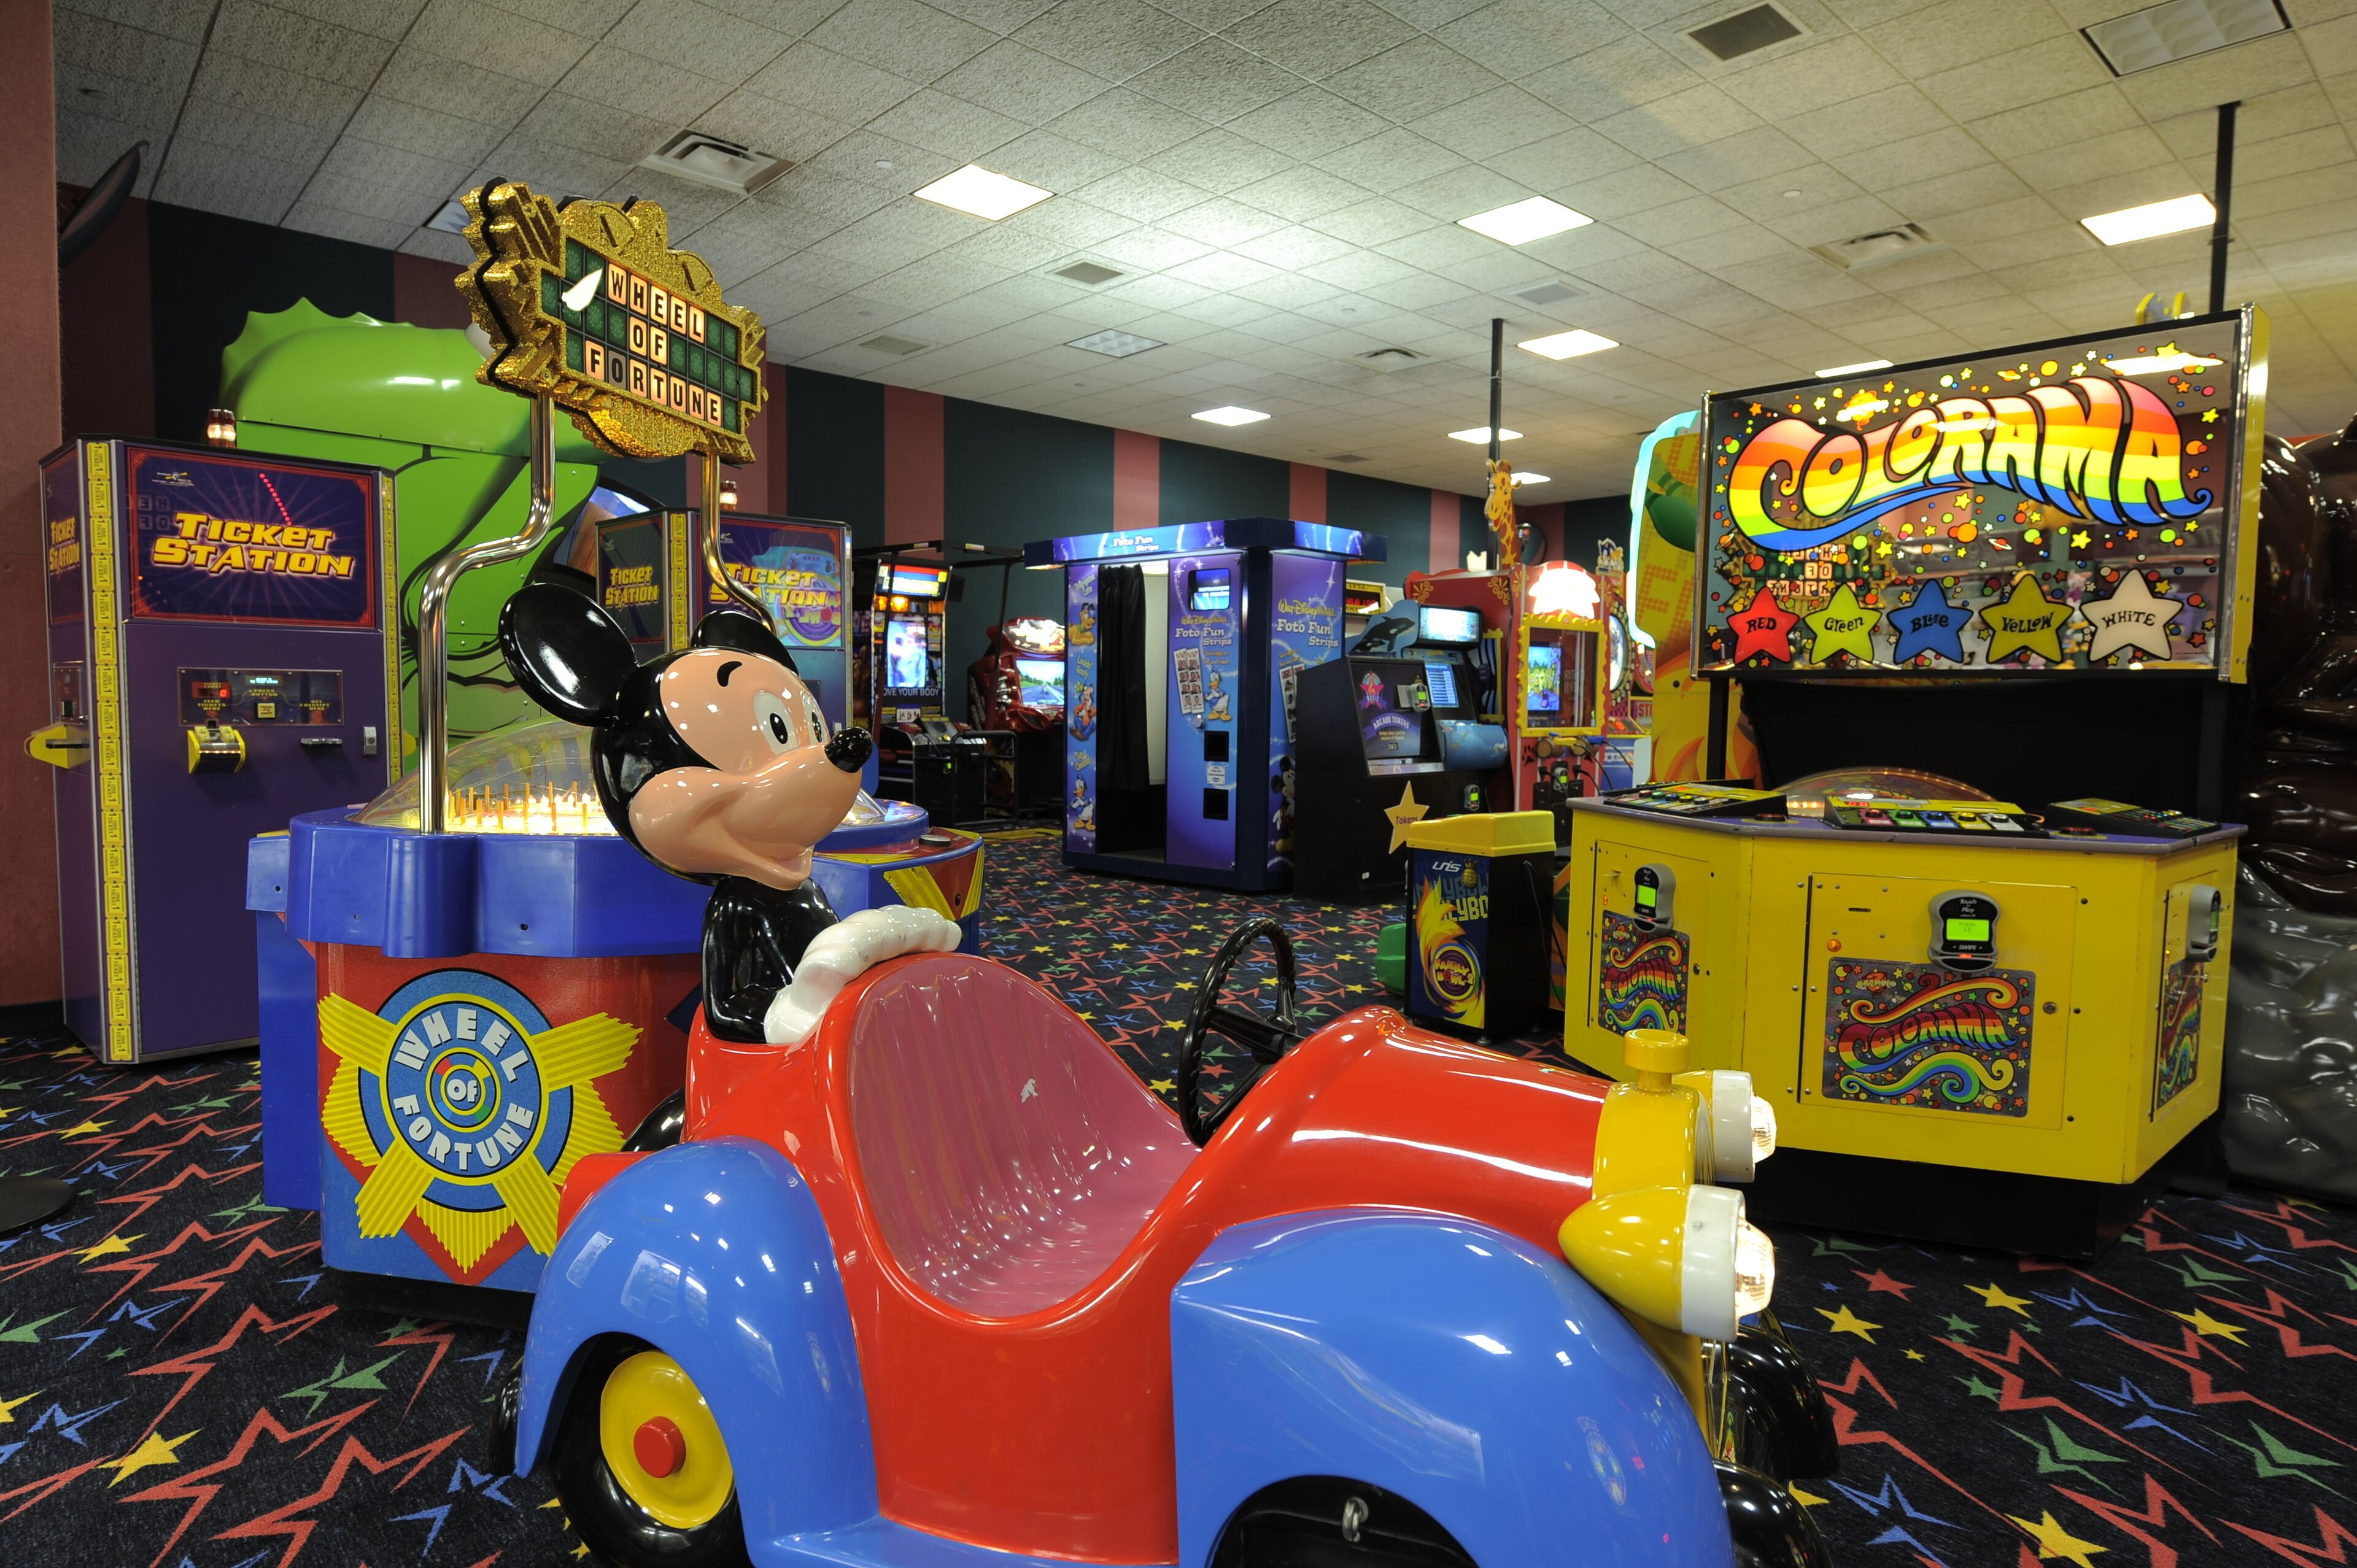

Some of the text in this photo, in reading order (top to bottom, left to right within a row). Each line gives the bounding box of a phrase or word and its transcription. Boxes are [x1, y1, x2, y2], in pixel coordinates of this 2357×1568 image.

[611, 271, 702, 337] WHEEL
[633, 323, 664, 357] OF
[590, 350, 718, 419] FORTUNE
[1728, 376, 2214, 552] COLORAMA
[176, 512, 333, 550] TICKET
[153, 537, 354, 577] STATION
[610, 566, 652, 586] TICKET
[605, 585, 659, 611] STATION
[710, 583, 827, 607] SATION
[1175, 627, 1225, 638] Foto Fun
[1277, 619, 1331, 635] Foto Fun
[1746, 616, 1777, 635] RED
[1202, 638, 1232, 647] Strips
[1308, 636, 1338, 648] Strips
[1373, 716, 1409, 730] ARCADE TOKENS
[1396, 816, 1418, 825] Tokens
[394, 1008, 528, 1082] WHEEL
[1838, 1003, 2018, 1073] COLORAMA
[393, 1094, 534, 1170] FORTUNE
